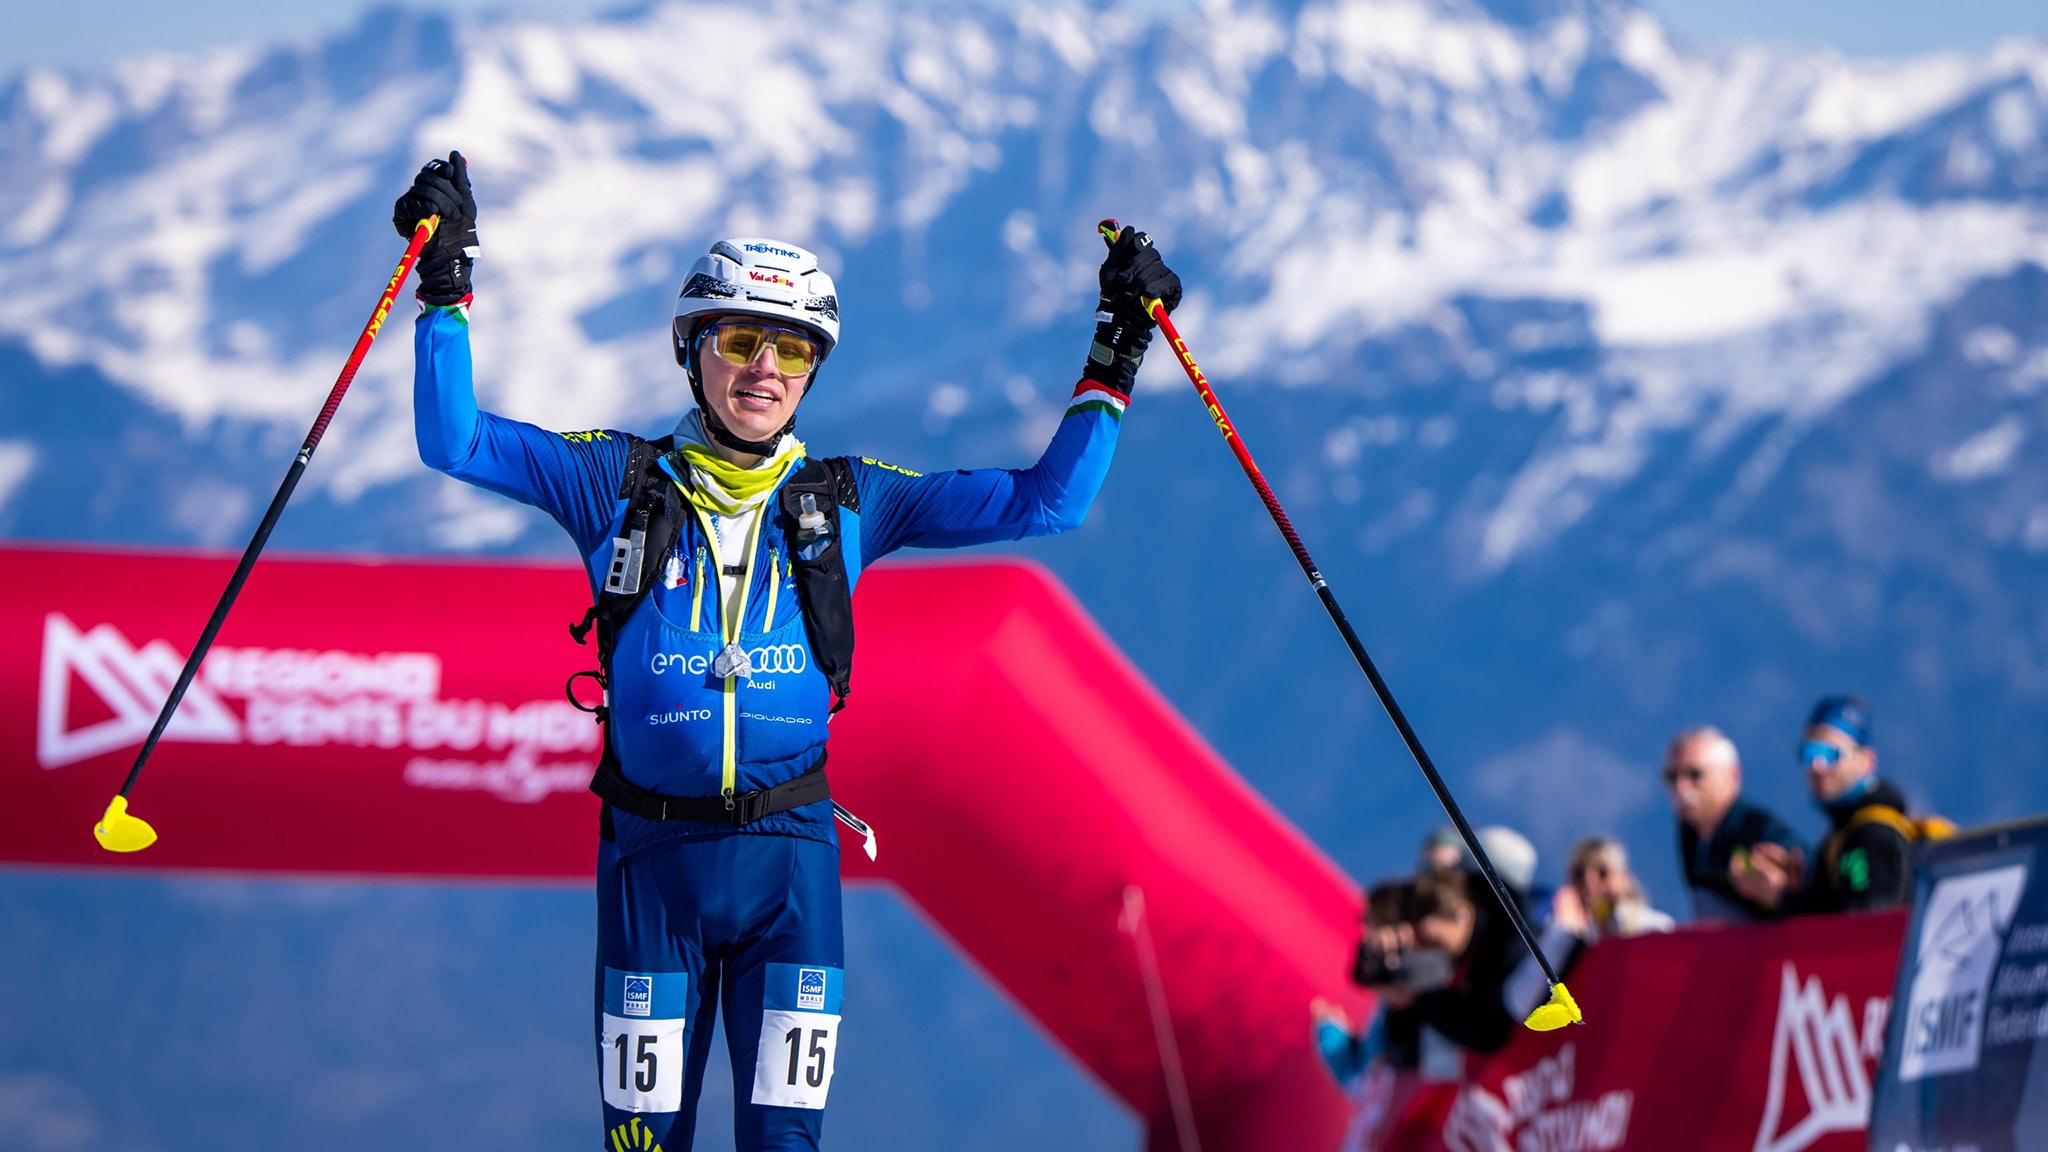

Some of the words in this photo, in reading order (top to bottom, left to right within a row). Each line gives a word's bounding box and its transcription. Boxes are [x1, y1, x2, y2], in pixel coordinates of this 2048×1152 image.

[744, 243, 800, 259] TRENTINO
[453, 258, 461, 278] PULL
[749, 271, 765, 281] Val
[772, 275, 795, 288] Sole
[366, 296, 394, 341] LEKI
[1174, 337, 1208, 385] LEKI
[1200, 390, 1233, 441] LEKI
[746, 680, 776, 690] Audi
[650, 709, 712, 726] SUUNTO
[740, 712, 813, 725] PIQUADRO
[627, 991, 648, 1000] ISMF
[802, 984, 822, 993] ISMF
[615, 1034, 657, 1092] 15
[785, 1027, 828, 1088] 15
